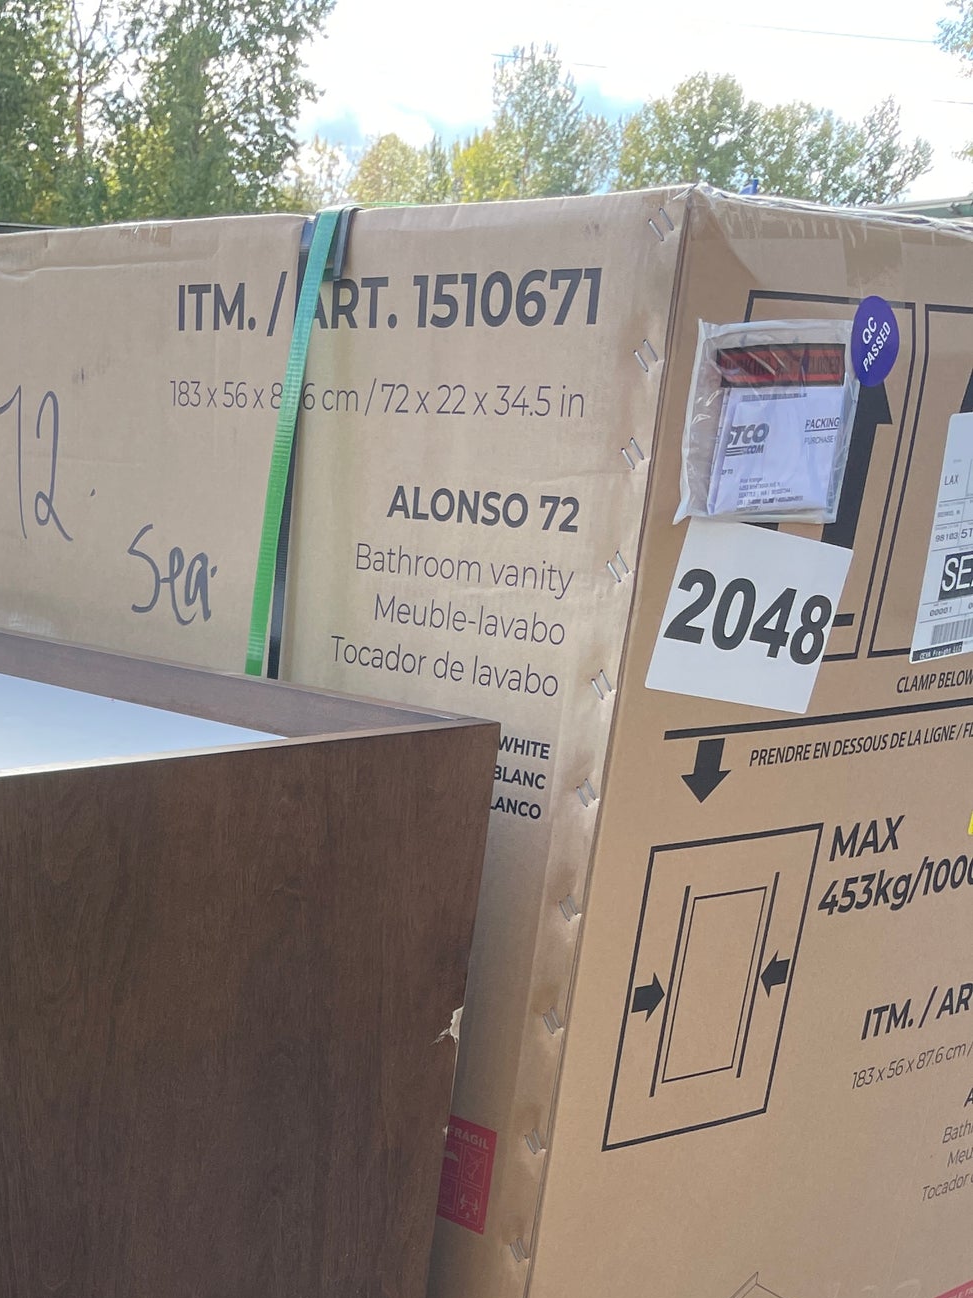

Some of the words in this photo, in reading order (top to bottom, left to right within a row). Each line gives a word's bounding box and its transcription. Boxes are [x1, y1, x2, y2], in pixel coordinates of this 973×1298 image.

[178, 283, 256, 331] ITM.
[266, 271, 288, 336] /
[414, 268, 602, 328] 1510671
[862, 317, 877, 345] QC
[863, 322, 891, 372] PASSED
[169, 381, 200, 408] 183
[206, 388, 217, 408] x
[224, 381, 247, 408] 56
[253, 389, 265, 408] x
[270, 382, 315, 411] 86
[322, 390, 358, 411] cm
[364, 378, 377, 416] /
[381, 384, 409, 413] 72
[416, 393, 429, 414] x
[436, 384, 466, 415] 22
[474, 394, 486, 415] x
[494, 385, 551, 417] 34.5
[560, 384, 585, 418] in
[805, 417, 840, 429] PACKING
[944, 475, 959, 486] LAX
[387, 484, 528, 529] ALONSO
[539, 495, 580, 534] 72
[355, 543, 483, 585] Bathroom
[489, 557, 575, 601] vanity
[942, 555, 973, 591] SE
[374, 594, 565, 646] Meuble-lavabo
[663, 569, 832, 665] 2048
[331, 635, 426, 678] Tocador
[433, 651, 464, 684] de
[473, 652, 559, 698] lavabo
[896, 674, 936, 693] CLAMP
[499, 736, 550, 760] WHITE
[749, 744, 811, 767] PRENDRE
[813, 740, 828, 759] EN
[832, 733, 888, 757] DESSOUS
[890, 731, 906, 749] DE
[907, 729, 921, 746] LA
[924, 724, 957, 744] LIGNE
[494, 765, 546, 790] BLANC
[490, 796, 542, 819] ANCO
[829, 815, 905, 862] MAX
[861, 999, 913, 1040] ITM.
[918, 986, 938, 1028] /
[852, 1066, 875, 1089] 183
[876, 1067, 885, 1082] x
[887, 1058, 905, 1078] 56
[906, 1059, 914, 1073] x
[945, 1043, 966, 1060] cm
[922, 1173, 969, 1202] Tocador
